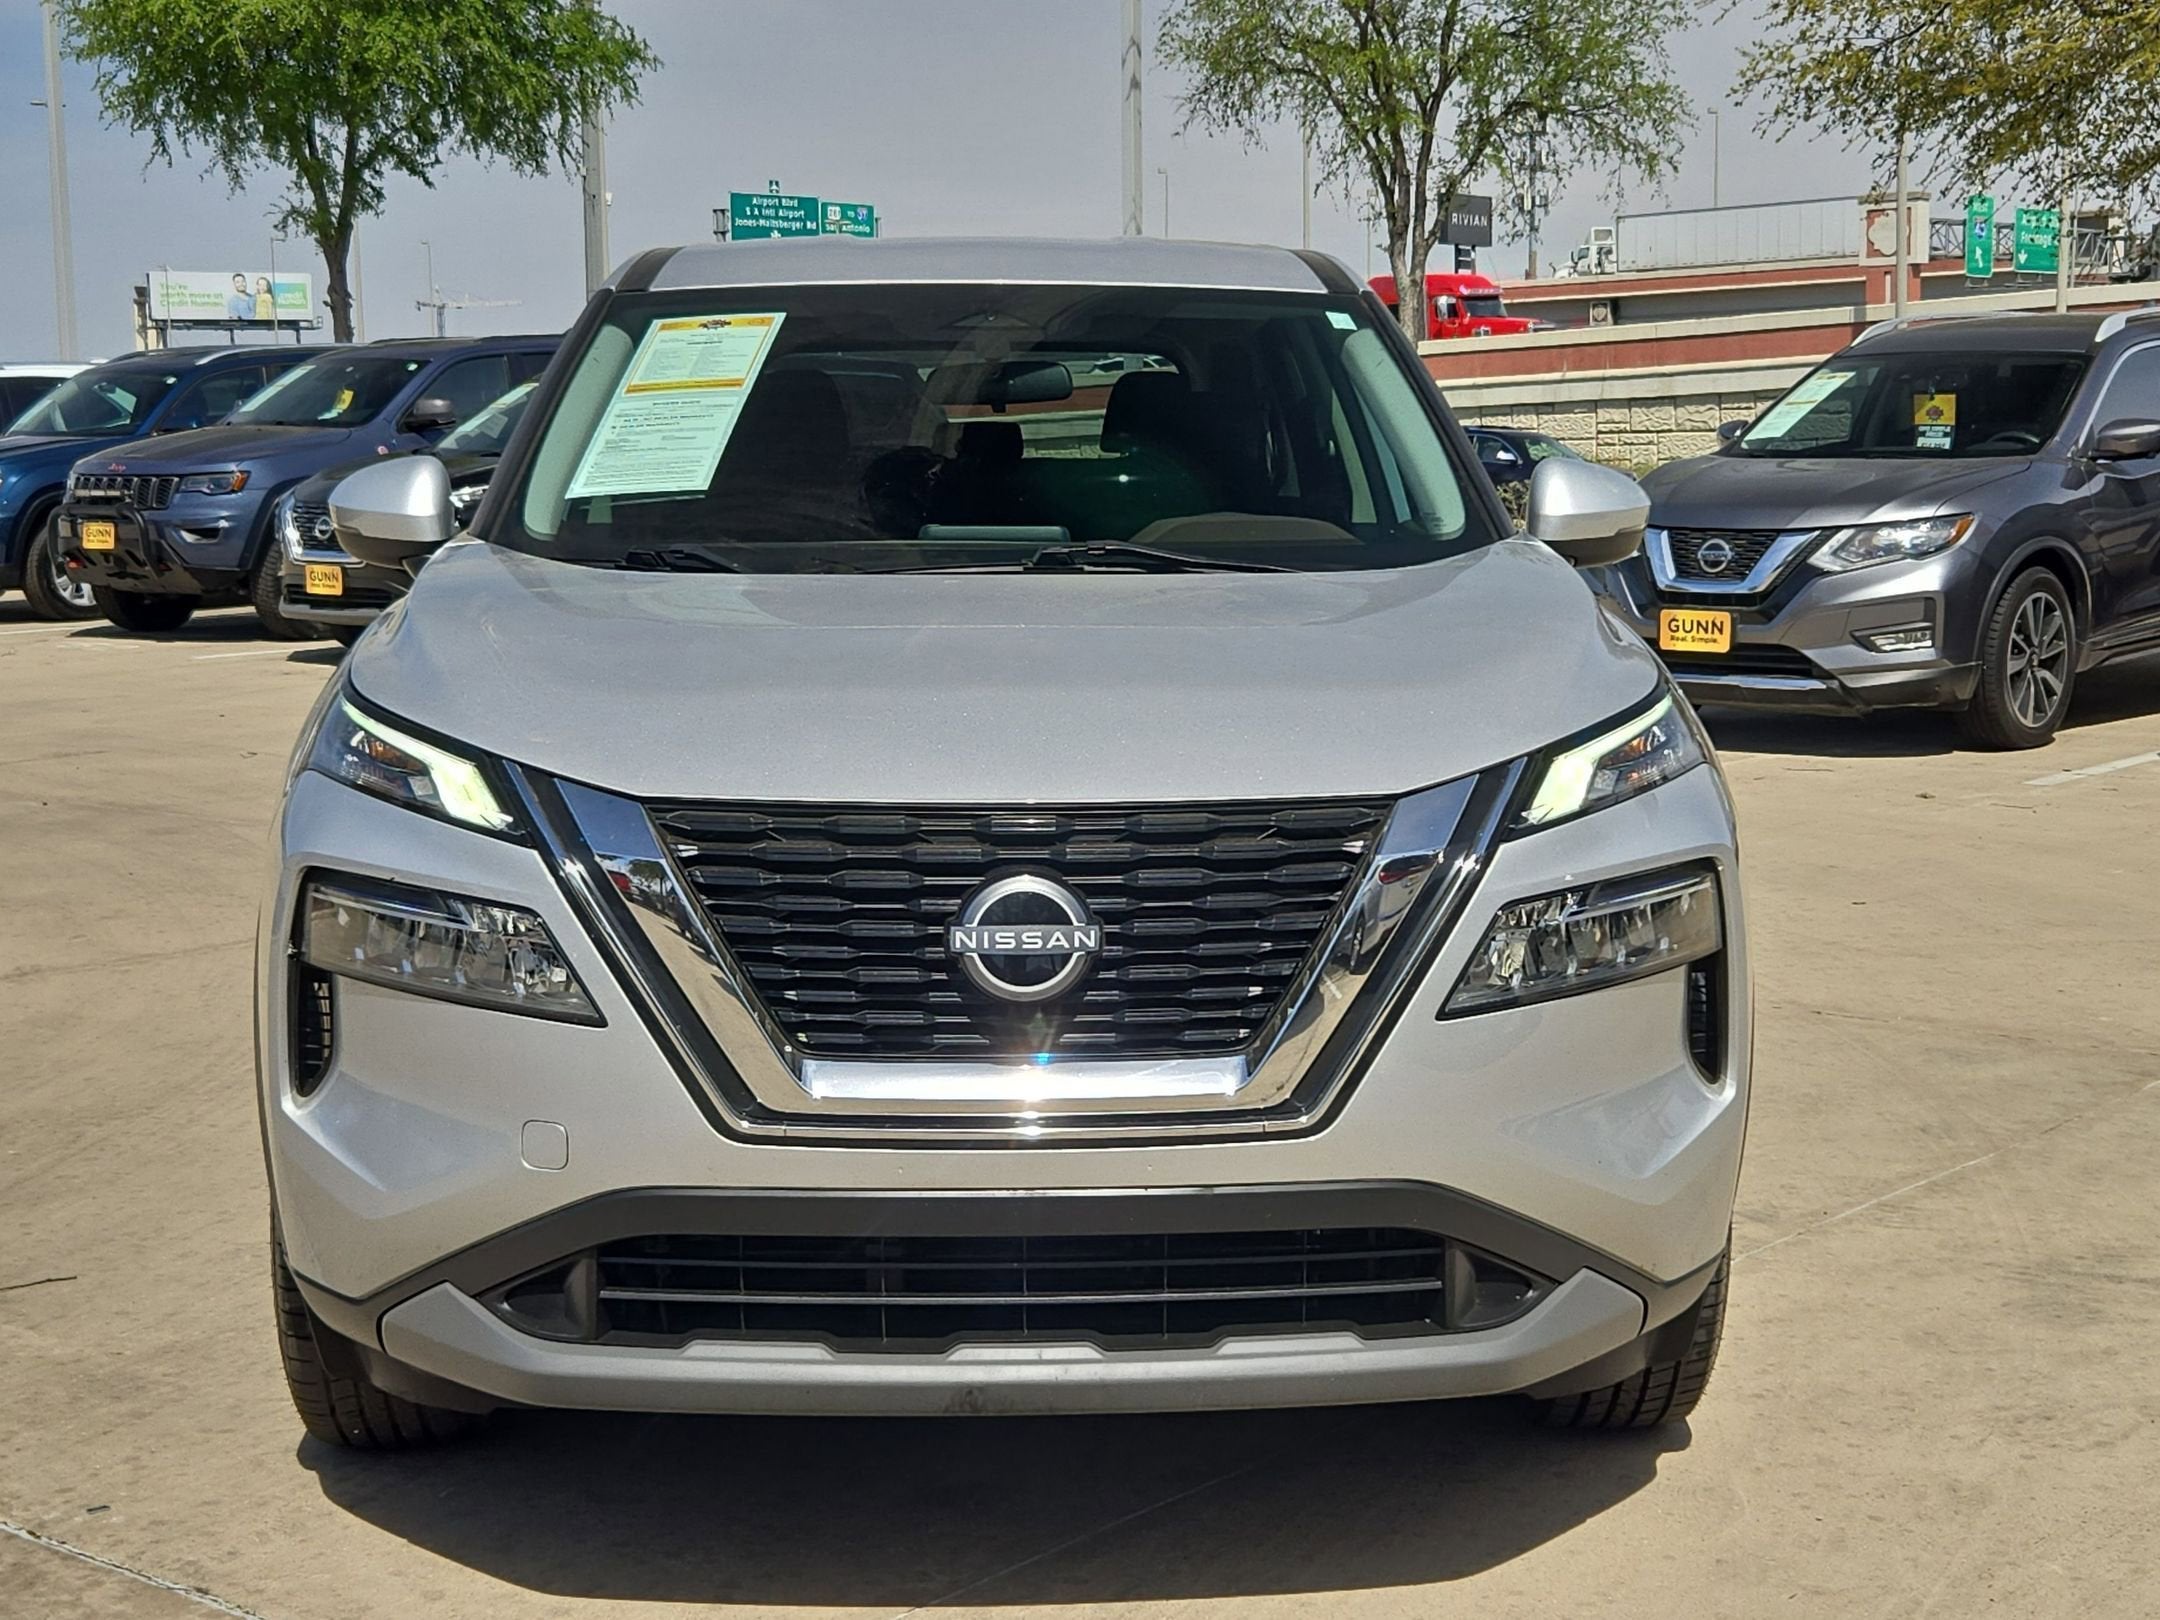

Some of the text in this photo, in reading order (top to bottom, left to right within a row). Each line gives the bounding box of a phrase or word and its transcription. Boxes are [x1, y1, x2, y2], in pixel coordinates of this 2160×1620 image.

[752, 196, 798, 207] Airport Blvd
[753, 207, 759, 216] A
[778, 208, 805, 219] Airport
[806, 220, 817, 230] Rd
[1452, 212, 1488, 227] RIVIAN
[841, 223, 871, 234] Antonio
[85, 527, 112, 538] GUNN
[310, 570, 339, 583] GUNN
[1668, 618, 1724, 635] GUNN
[954, 930, 1096, 949] NISSAN
